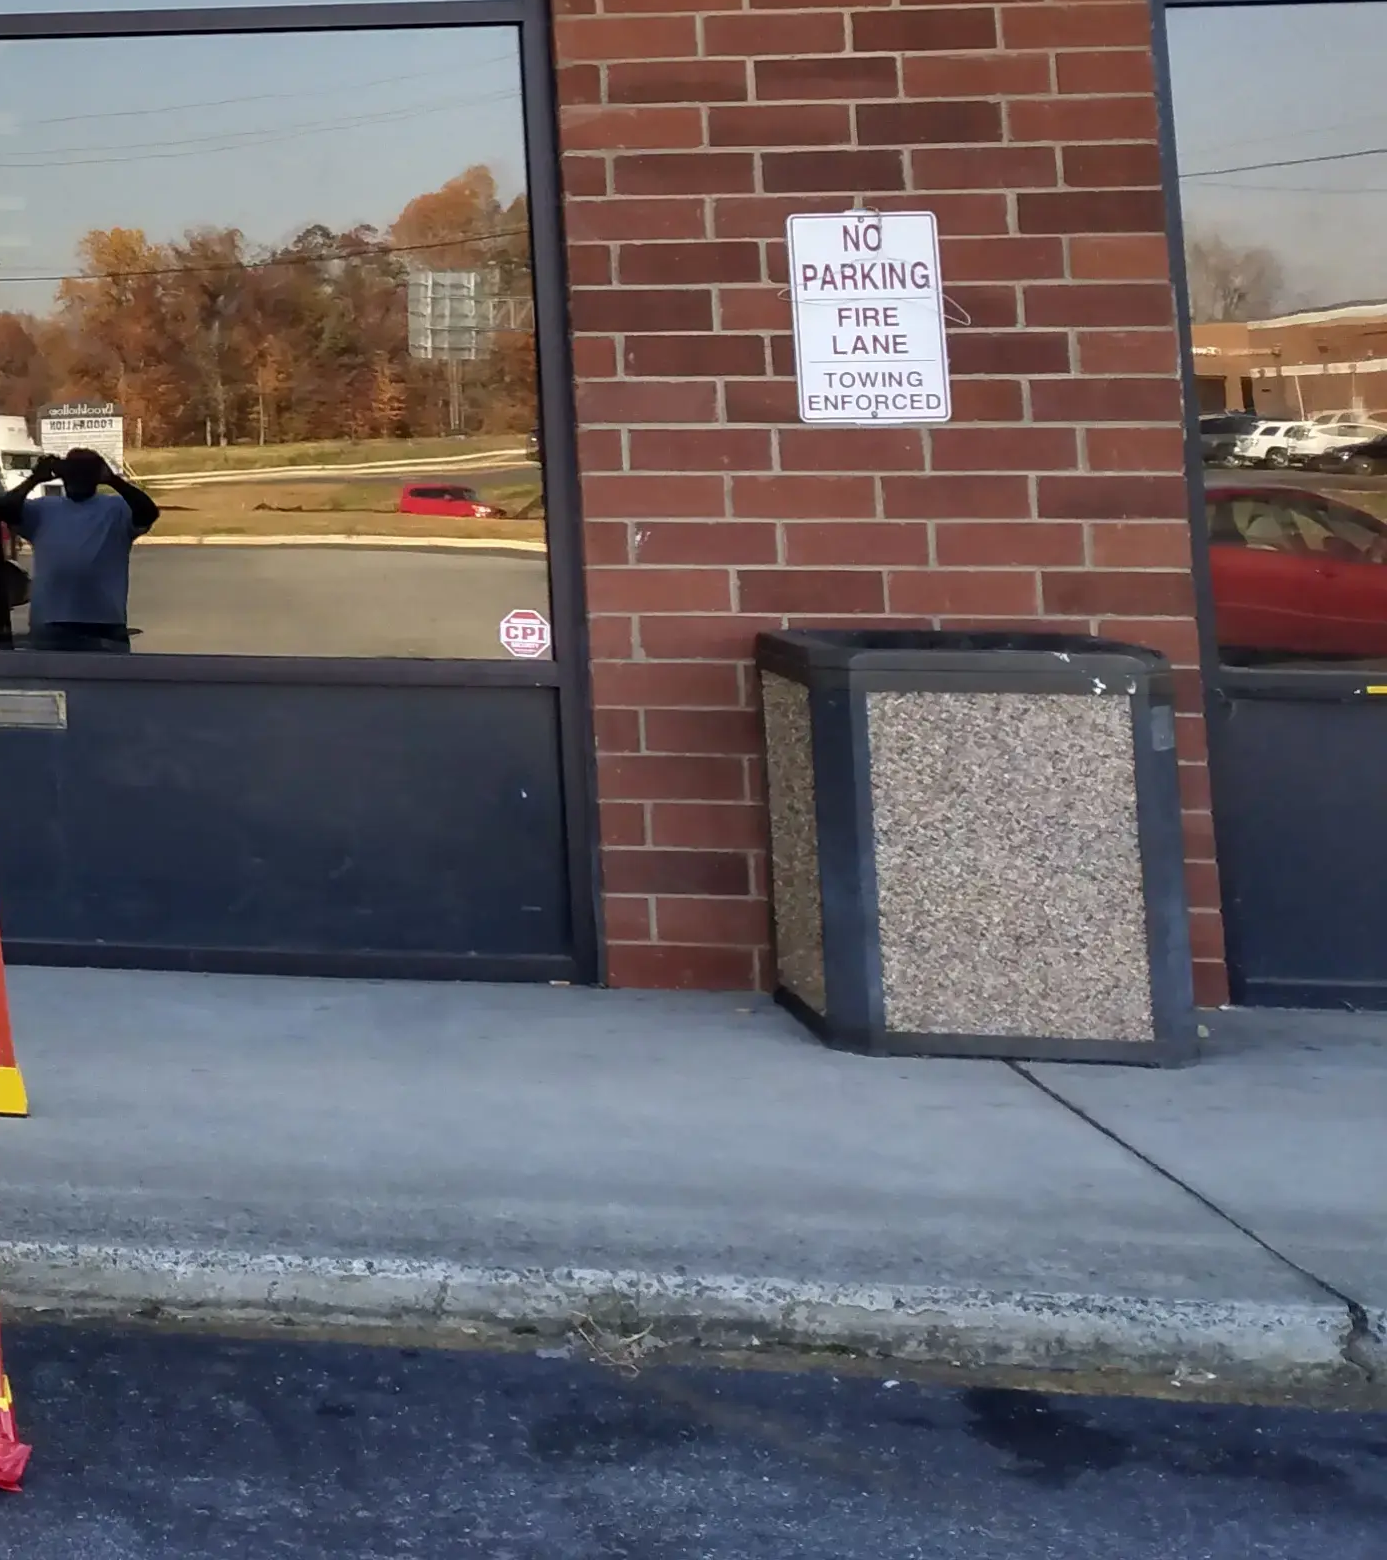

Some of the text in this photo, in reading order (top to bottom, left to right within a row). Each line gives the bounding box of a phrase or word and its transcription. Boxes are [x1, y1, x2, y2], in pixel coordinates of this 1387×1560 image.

[842, 224, 882, 252] NO
[802, 261, 931, 291] PARKING
[838, 307, 900, 327] FIRE
[833, 334, 909, 355] LANE
[824, 371, 923, 389] TOWING
[808, 393, 941, 412] ENFORCED
[505, 625, 545, 642] CPI
